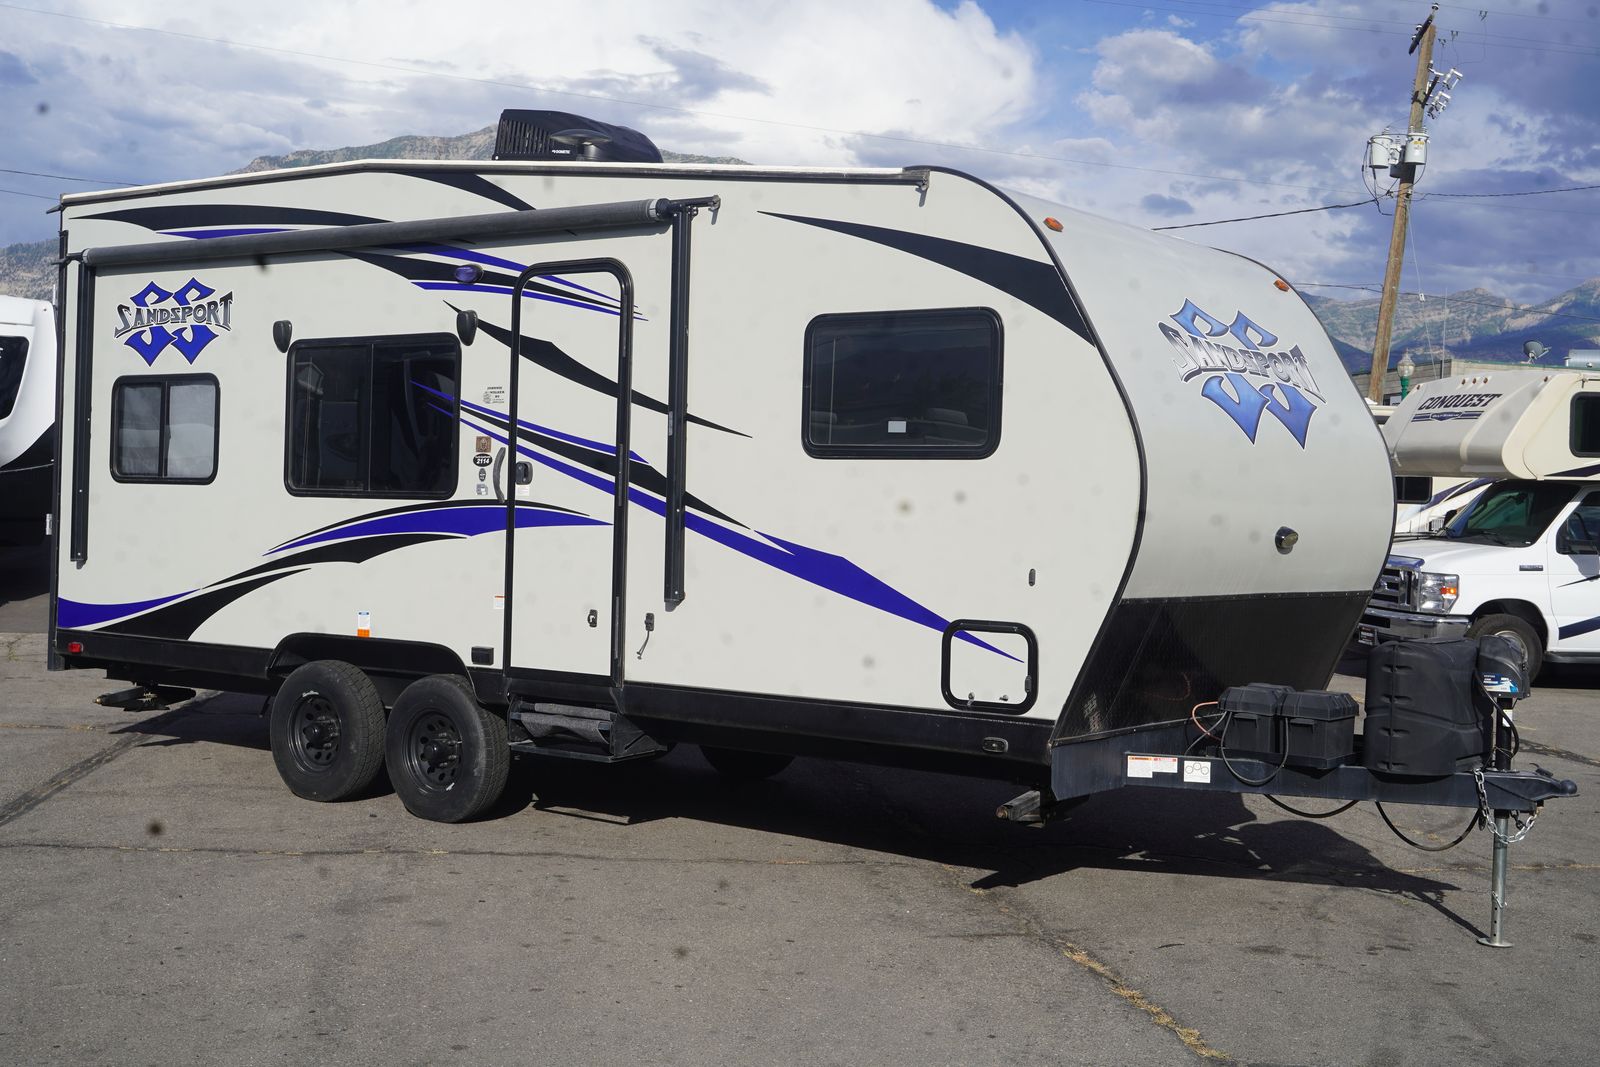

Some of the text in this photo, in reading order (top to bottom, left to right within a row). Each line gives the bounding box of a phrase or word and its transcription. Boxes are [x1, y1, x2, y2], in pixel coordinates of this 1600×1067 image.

[114, 290, 234, 339] SANDSPORT
[1158, 321, 1327, 403] SANDSPORT
[1417, 393, 1503, 411] CONQUEST
